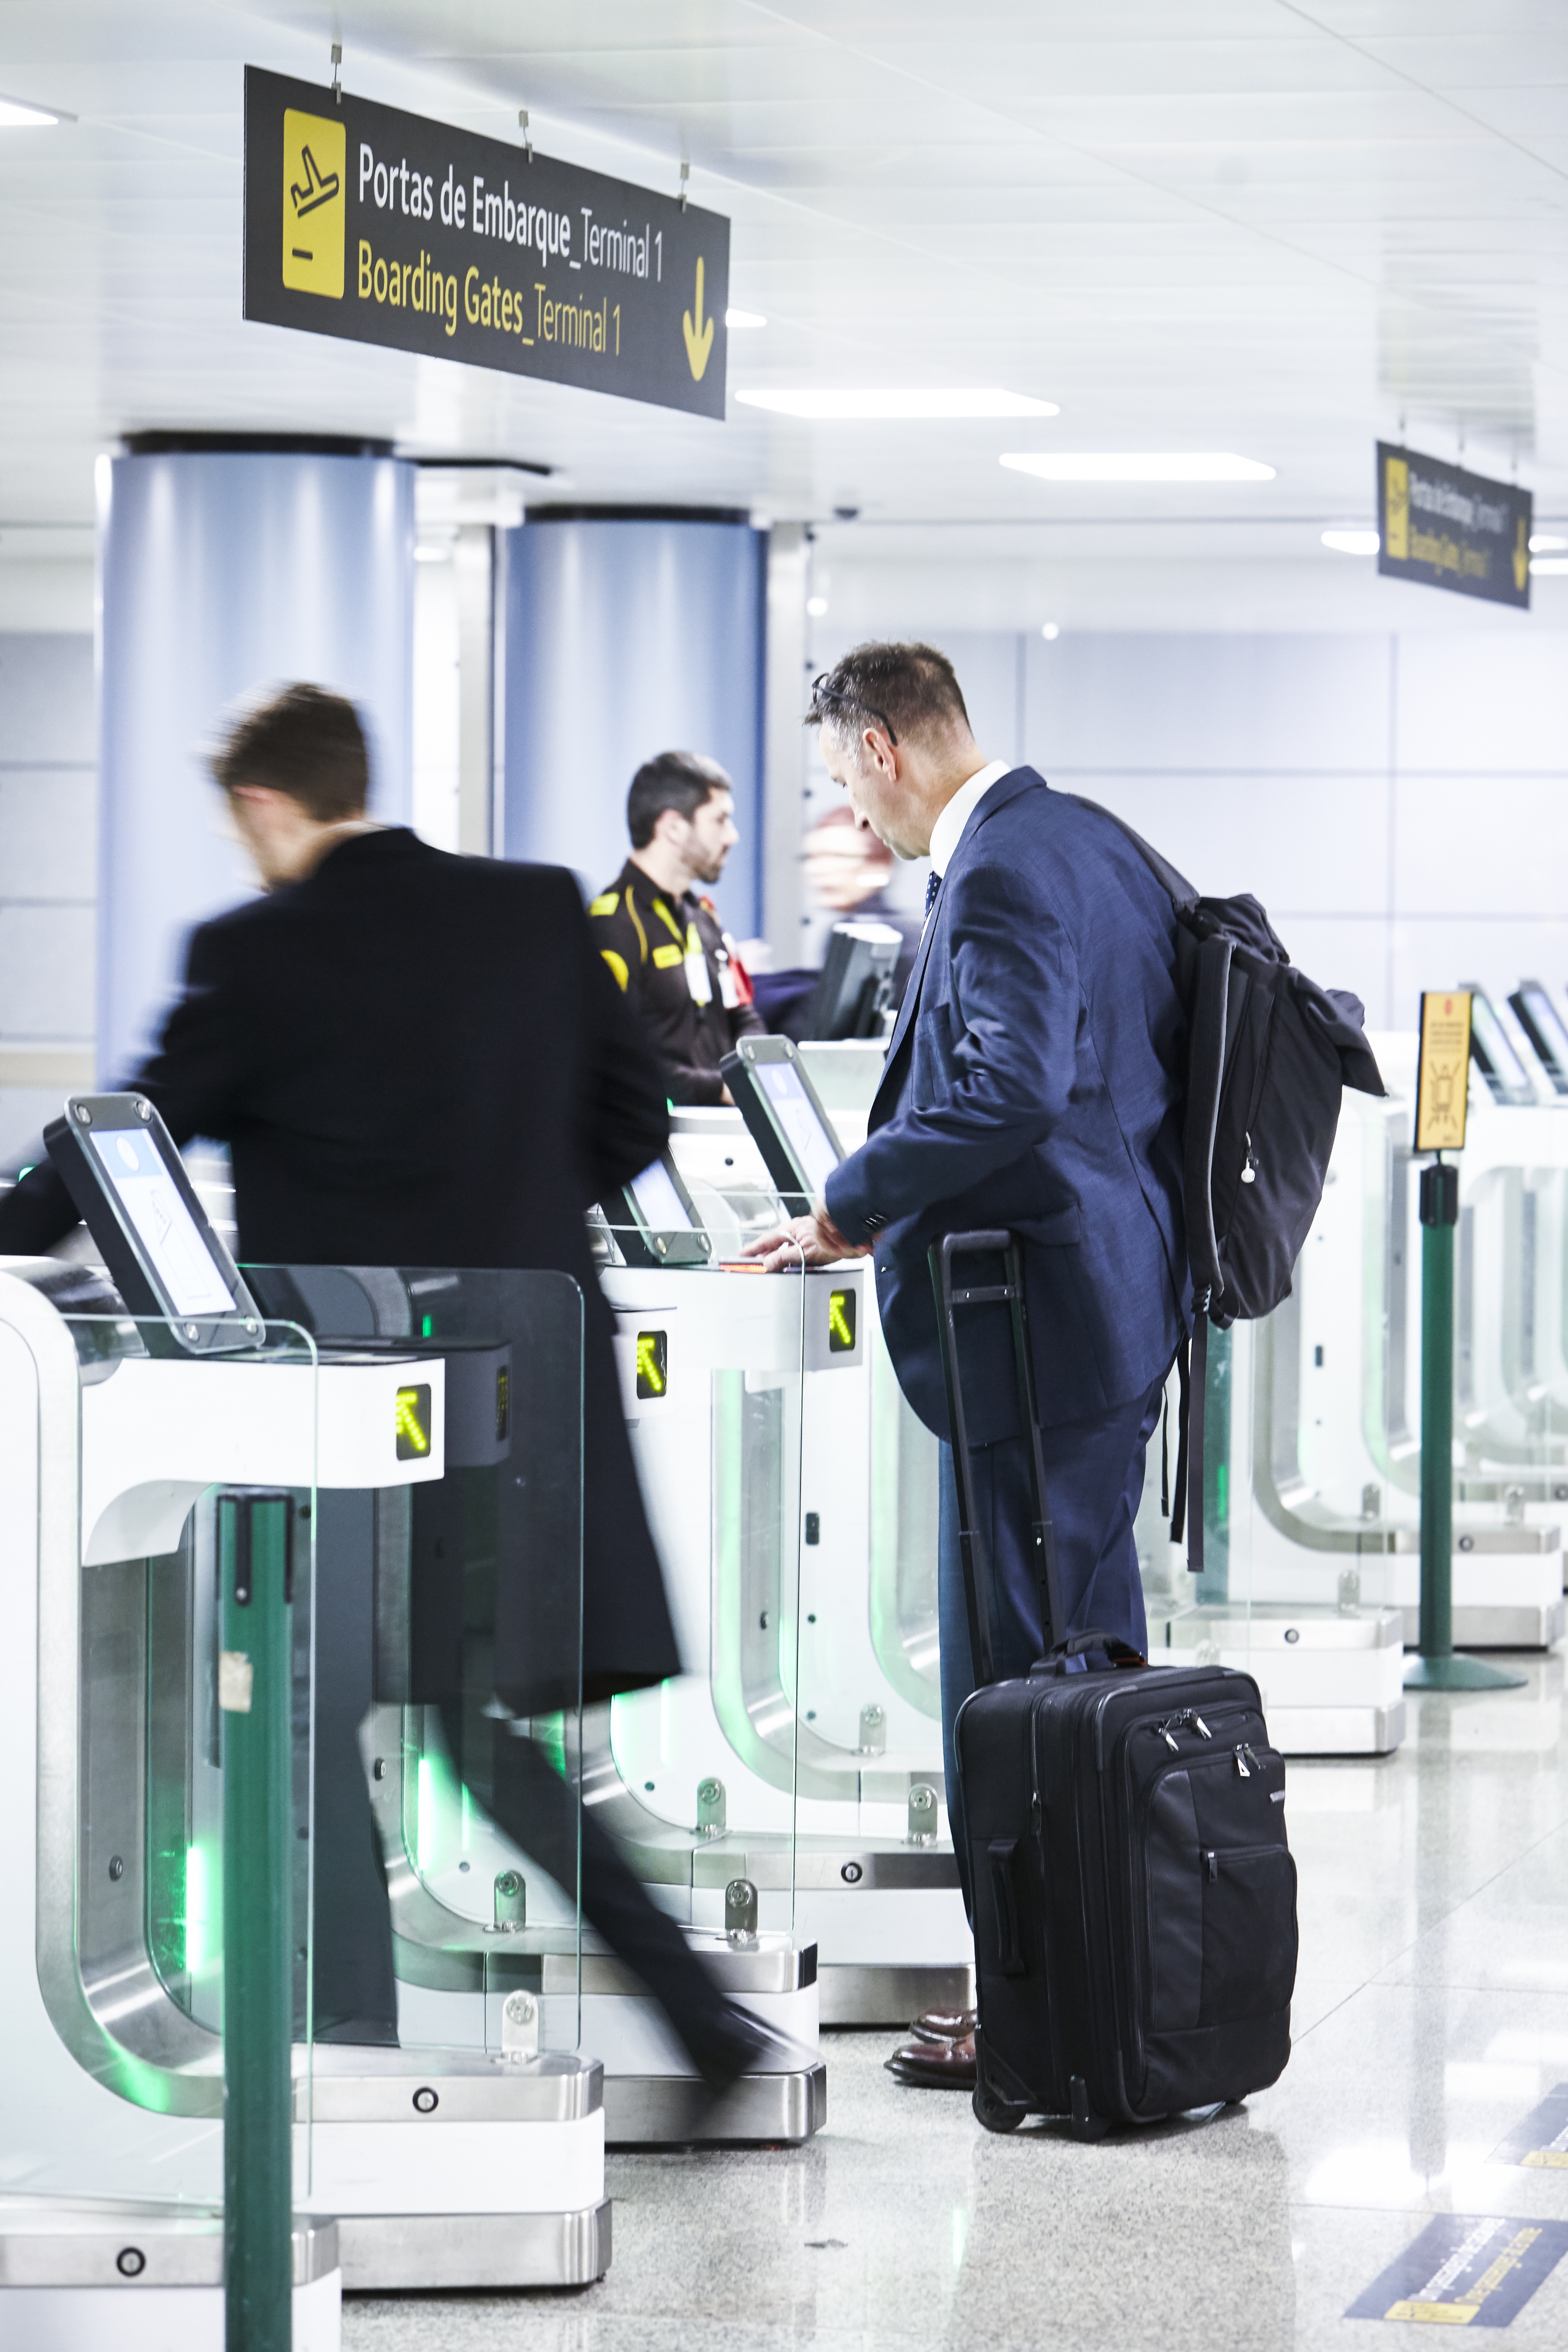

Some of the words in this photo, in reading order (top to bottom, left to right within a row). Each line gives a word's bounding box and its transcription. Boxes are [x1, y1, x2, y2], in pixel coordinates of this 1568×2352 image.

[359, 142, 433, 220] Portas
[440, 164, 466, 229] de
[654, 230, 663, 283] 1
[358, 239, 457, 336] Boarding
[613, 304, 620, 356] 1
